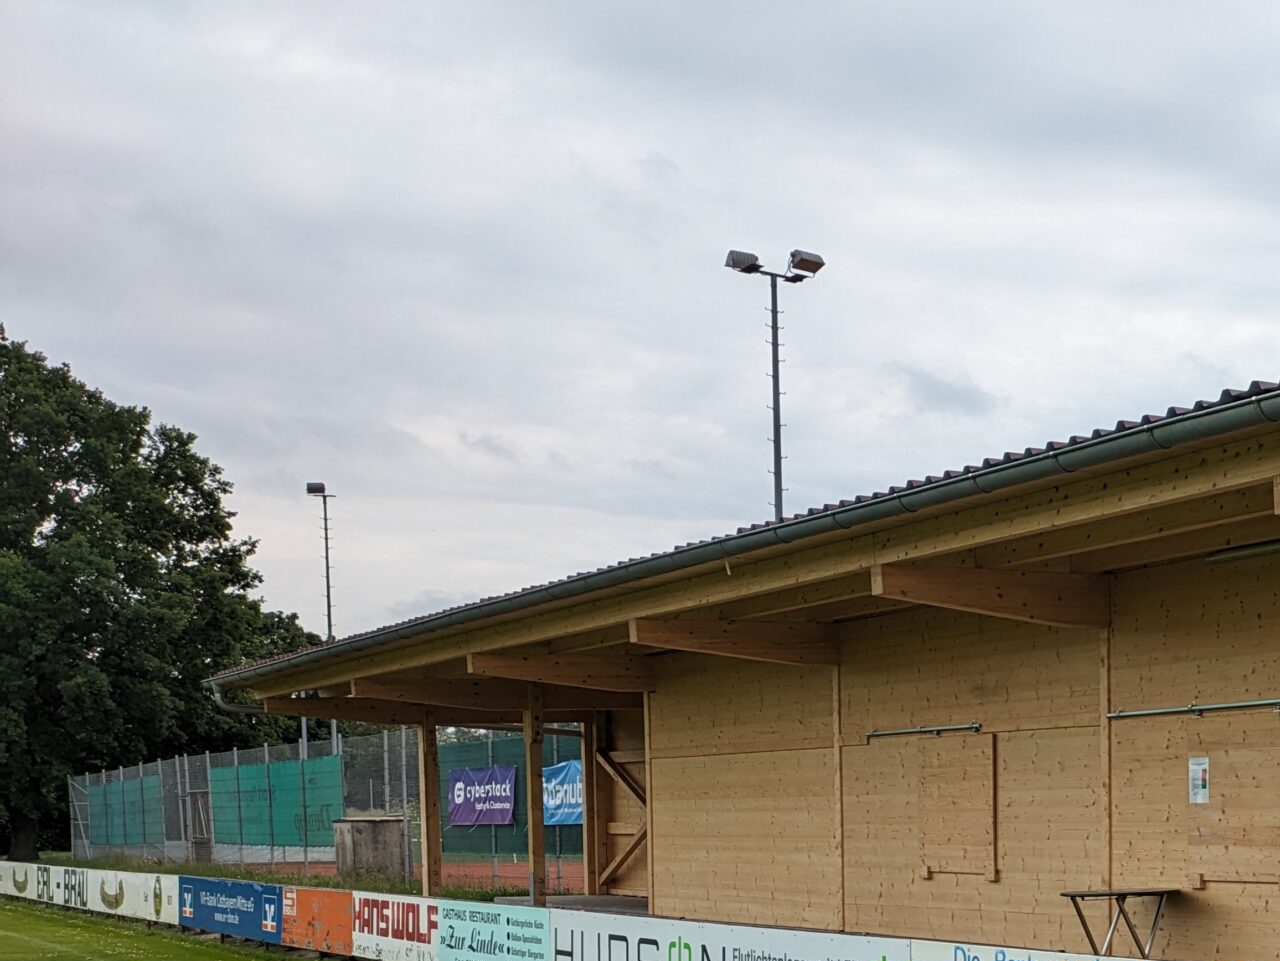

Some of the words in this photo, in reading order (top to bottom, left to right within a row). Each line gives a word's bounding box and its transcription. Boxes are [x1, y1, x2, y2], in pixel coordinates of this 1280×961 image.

[466, 780, 511, 802] cyberstack
[442, 908, 467, 922] GASTHAUS
[468, 910, 502, 926] RESTAURANT
